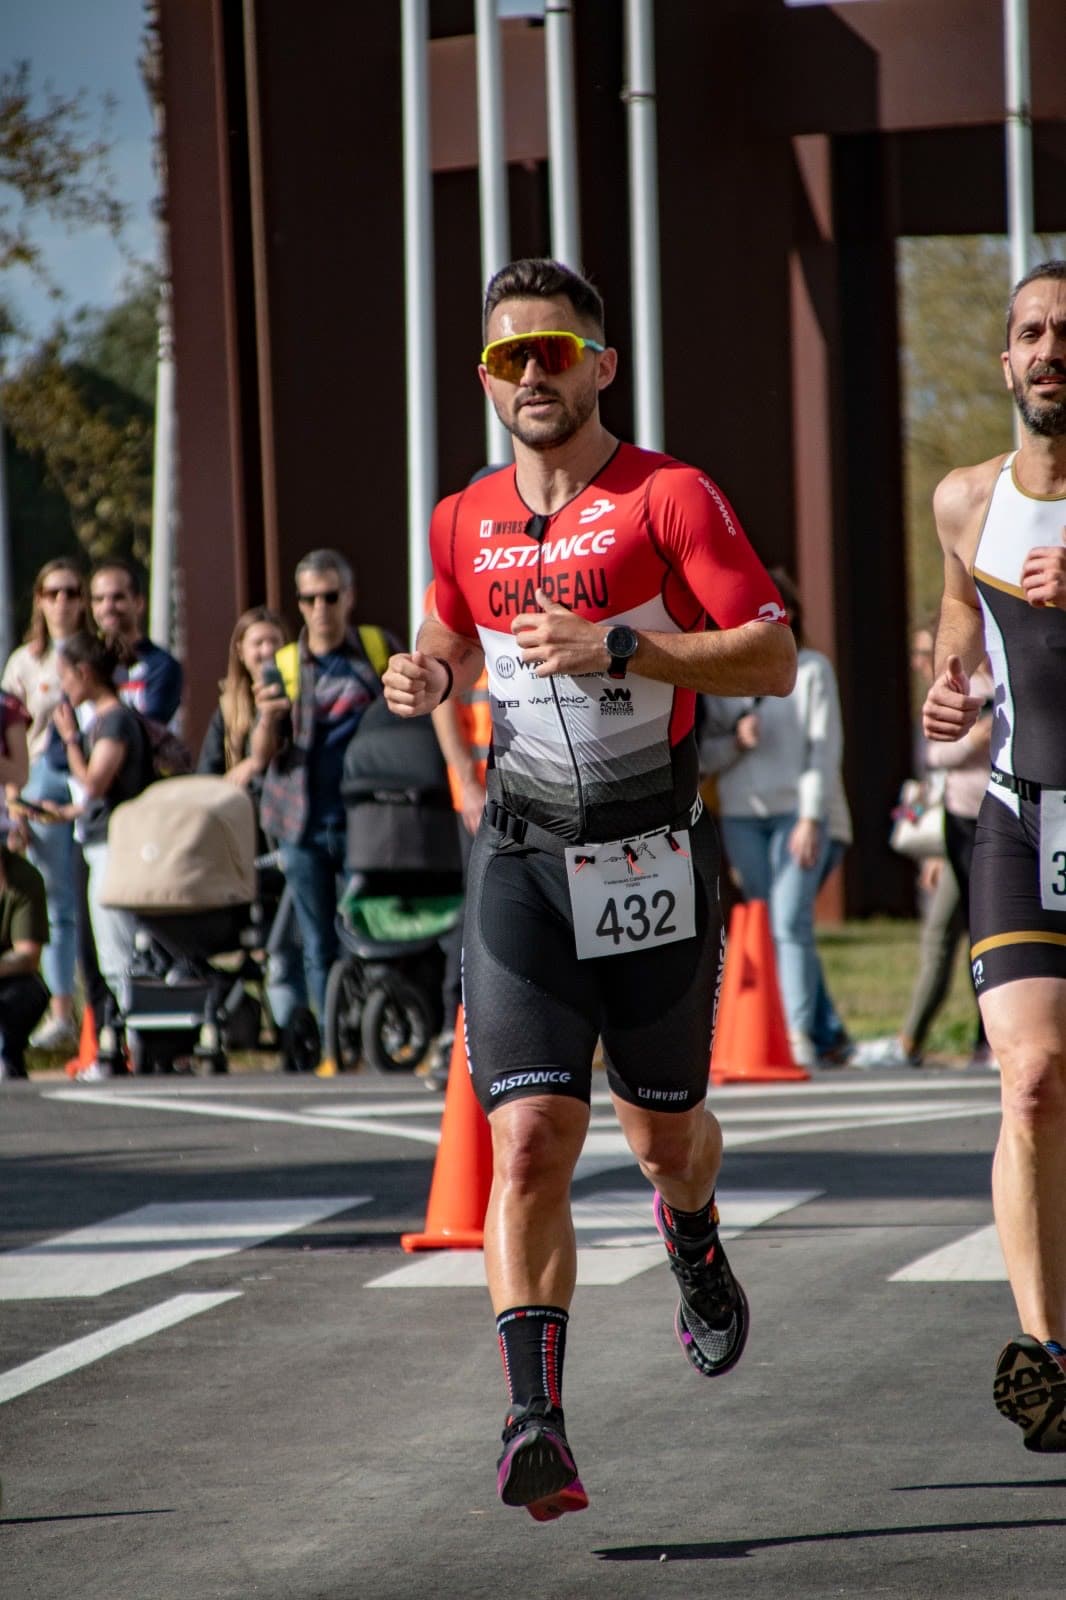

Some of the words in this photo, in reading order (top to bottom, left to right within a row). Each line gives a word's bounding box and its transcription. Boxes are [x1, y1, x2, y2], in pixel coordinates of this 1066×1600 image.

[473, 527, 616, 573] DISTANCE
[488, 567, 609, 618] CHAPEAU
[595, 889, 677, 945] 432
[489, 1071, 572, 1096] DISTANCE
